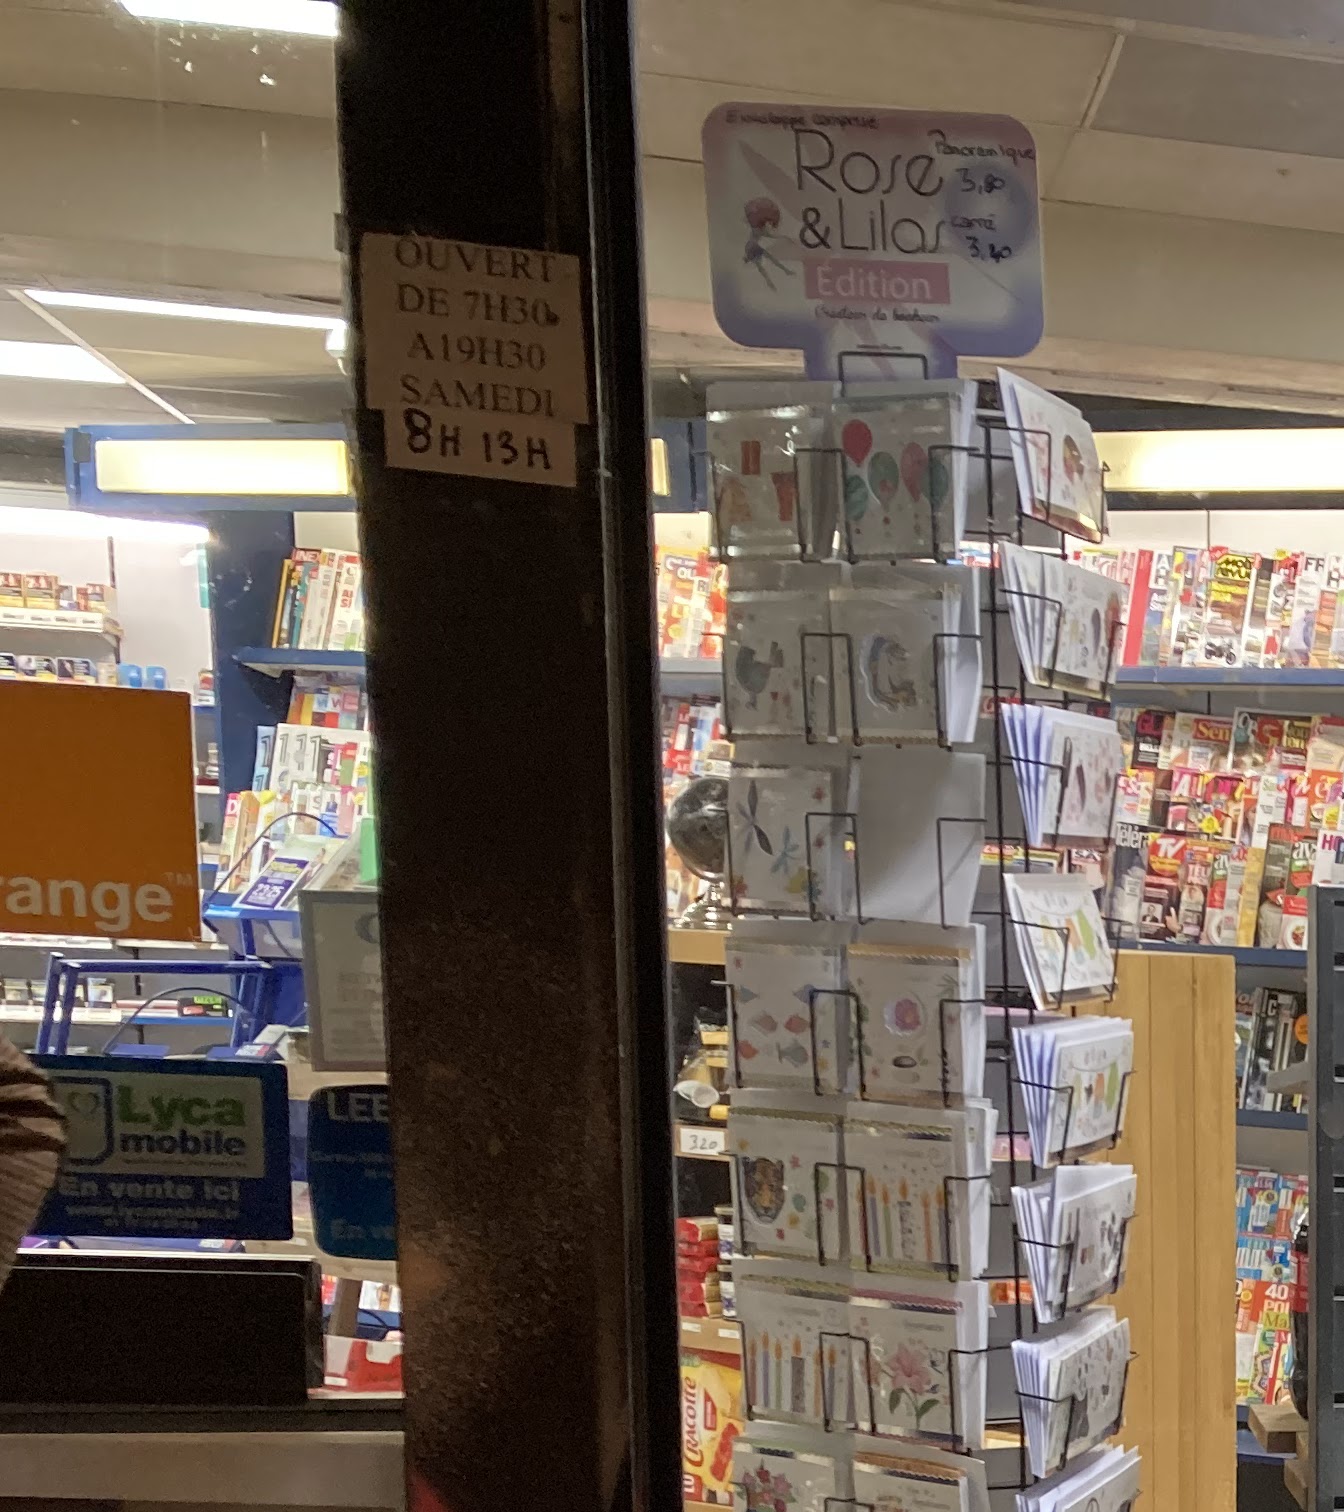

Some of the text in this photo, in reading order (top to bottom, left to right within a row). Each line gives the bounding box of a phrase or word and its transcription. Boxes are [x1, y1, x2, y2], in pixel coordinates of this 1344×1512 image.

[794, 127, 944, 197] Rose
[394, 236, 556, 282] OUVERT
[817, 258, 932, 299] Édition
[397, 283, 551, 327] DE 7H30
[400, 373, 556, 418] SAMEDI
[0, 874, 173, 933] ange
[118, 1084, 246, 1132] Lyca
[119, 1127, 246, 1157] mobile
[59, 1176, 98, 1197] En
[108, 1178, 193, 1200] vente
